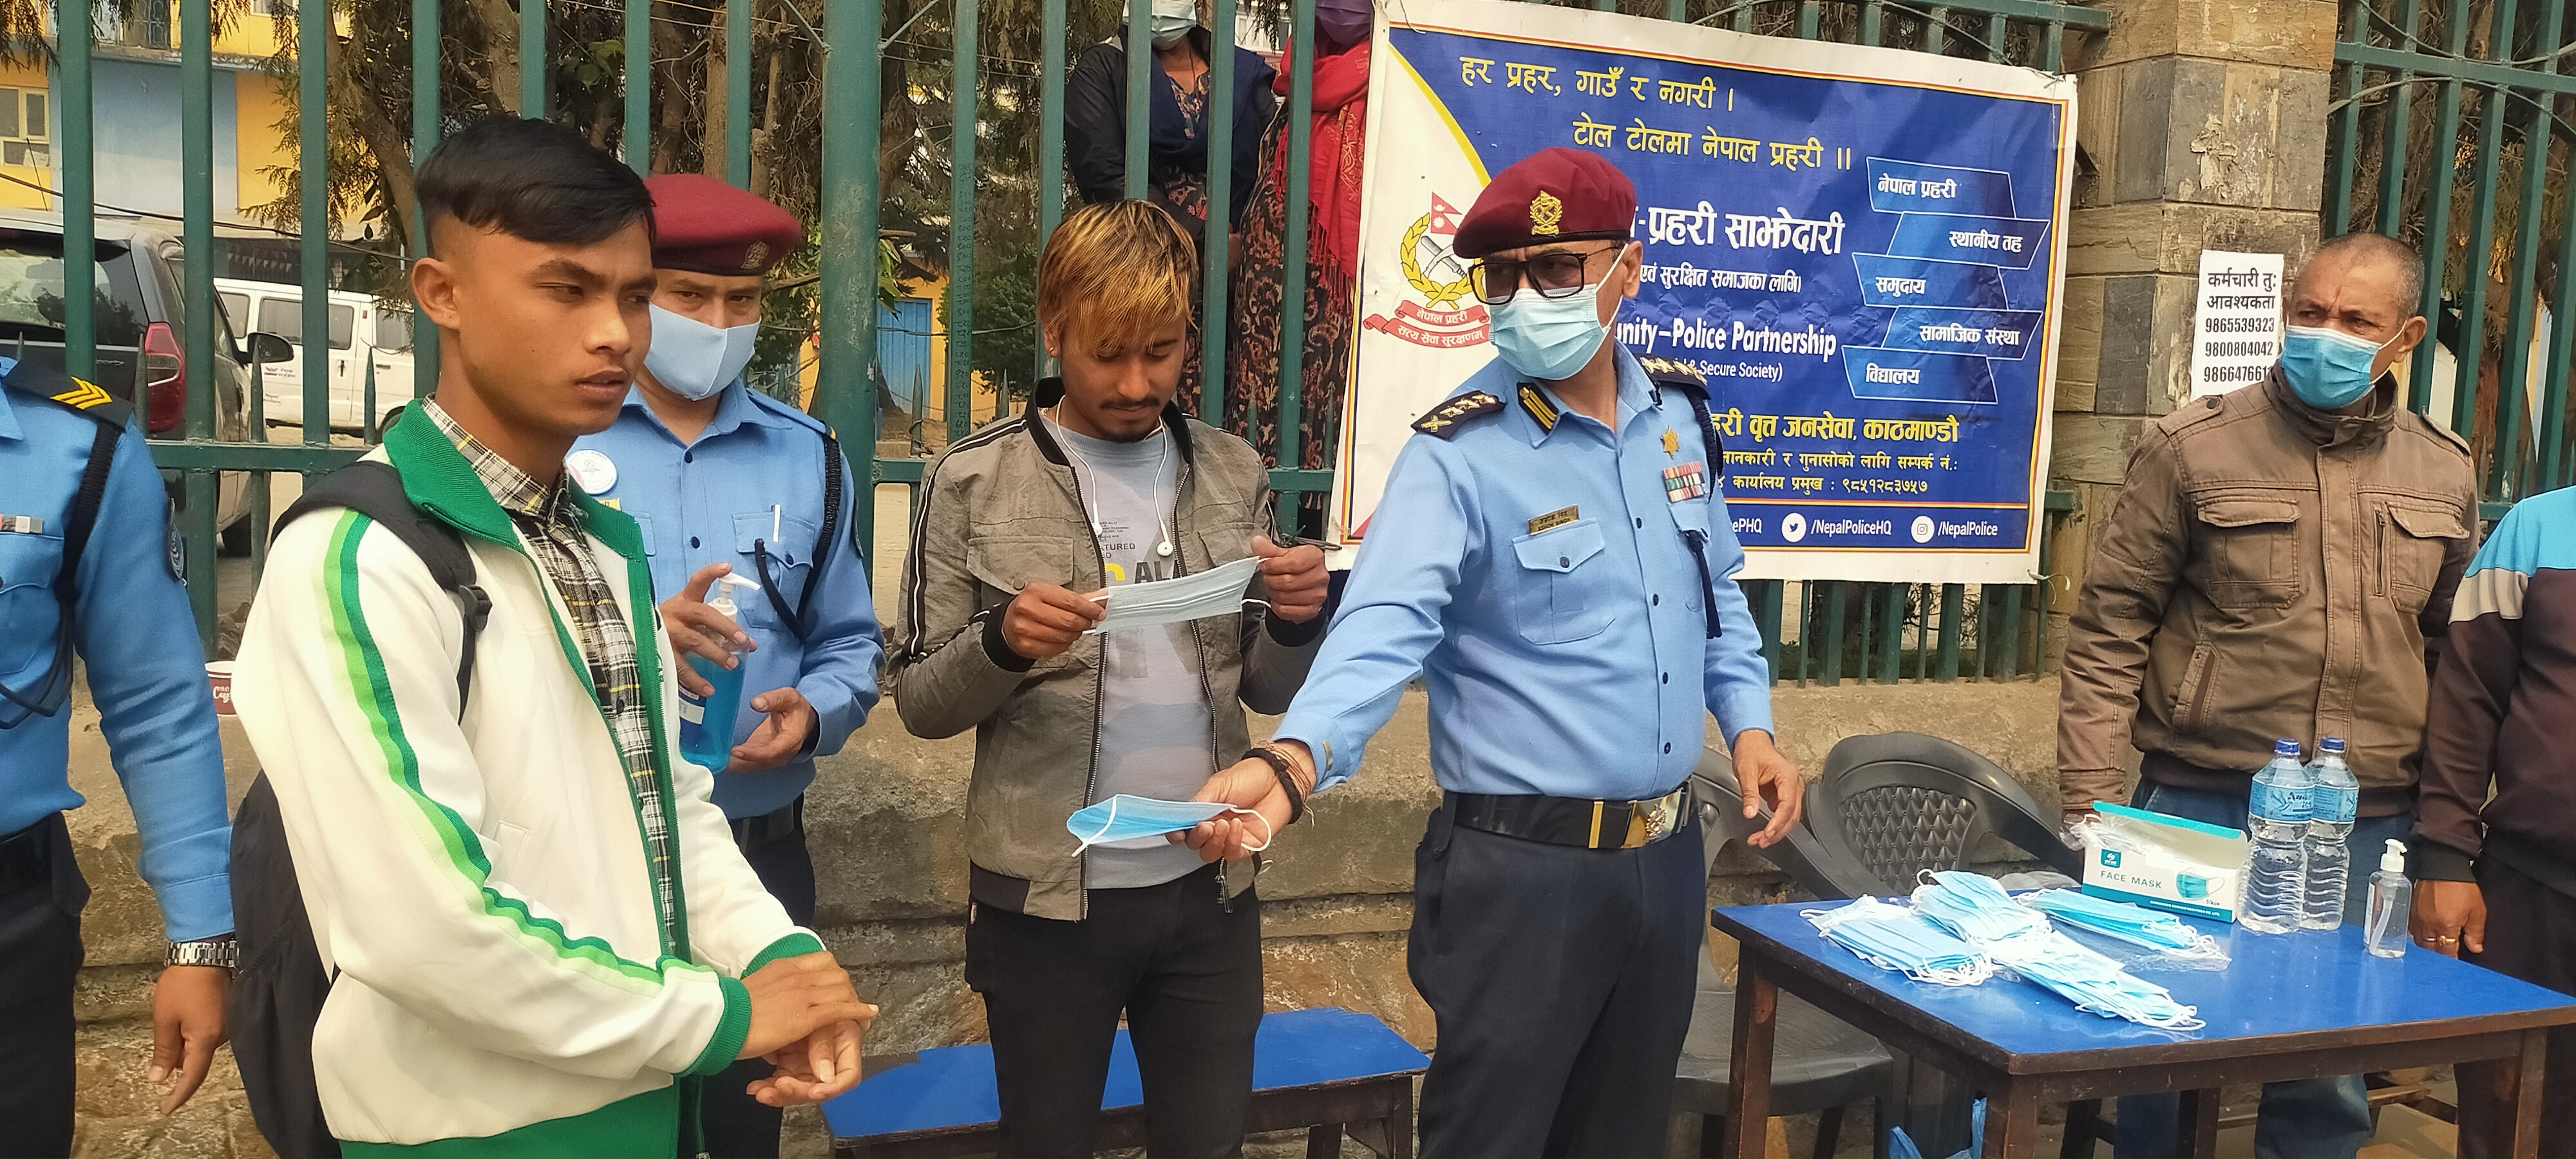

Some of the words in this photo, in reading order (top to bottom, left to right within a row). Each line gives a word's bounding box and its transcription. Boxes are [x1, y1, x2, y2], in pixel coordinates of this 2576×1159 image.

[1459, 57, 1495, 86] हर
[1505, 61, 1562, 96] प्रहर,
[1575, 66, 1625, 99] गाउँ
[1629, 76, 1649, 100] र
[1658, 76, 1716, 108] नगरी
[1572, 112, 1616, 147] टोल
[1625, 118, 1692, 155] टोलमा
[1701, 126, 1761, 162] नेपाल
[1769, 137, 1824, 171] प्रहरी
[1877, 173, 1917, 196] नेपाल
[1920, 178, 1957, 199] प्रहरी
[1725, 207, 1846, 256] साझेदारी
[1949, 229, 2000, 250] स्थानीय
[2002, 234, 2023, 253] तह
[1660, 261, 1709, 290] सुरक्षित
[1710, 269, 1767, 290] समाजका
[1875, 276, 1927, 297] समुदाय
[2208, 267, 2259, 288] कर्मचारी
[2206, 295, 2276, 310] आवश्यकता
[1416, 308, 1443, 324] नेपाल
[1444, 310, 1468, 325] प्रहरी
[2205, 317, 2275, 333] 9865539323
[1397, 325, 1420, 341] सत्य
[1421, 332, 1440, 345] सेवा
[1731, 321, 1837, 363] Partnership
[1918, 322, 1982, 343] सामाजिक
[1984, 327, 2020, 346] संस्था
[2205, 341, 2273, 357] 9800804042
[1699, 359, 1737, 377] Secure
[1738, 362, 1783, 382] Society)
[1865, 363, 1920, 385] विद्यालय
[2203, 365, 2271, 382] 986647661
[1749, 415, 1779, 442] वृत्त
[1782, 410, 1857, 441] जनसेवा,
[1863, 414, 1960, 443] काठमाण्डौ
[1783, 453, 1794, 467] र
[1799, 450, 1855, 472] गुनासोको
[1860, 451, 1892, 469] लागि
[1897, 453, 1935, 471] सम्पर्क
[1732, 471, 1786, 491] कार्यालय
[1792, 476, 1824, 496] प्रमुख
[1842, 477, 1929, 496] ९८५१२८३७५७
[1810, 518, 1892, 536] /NepalPoliceHQ
[1937, 520, 1998, 537] /NepalPolice
[2100, 870, 2126, 883] FACE
[2131, 876, 2163, 889] MASK
